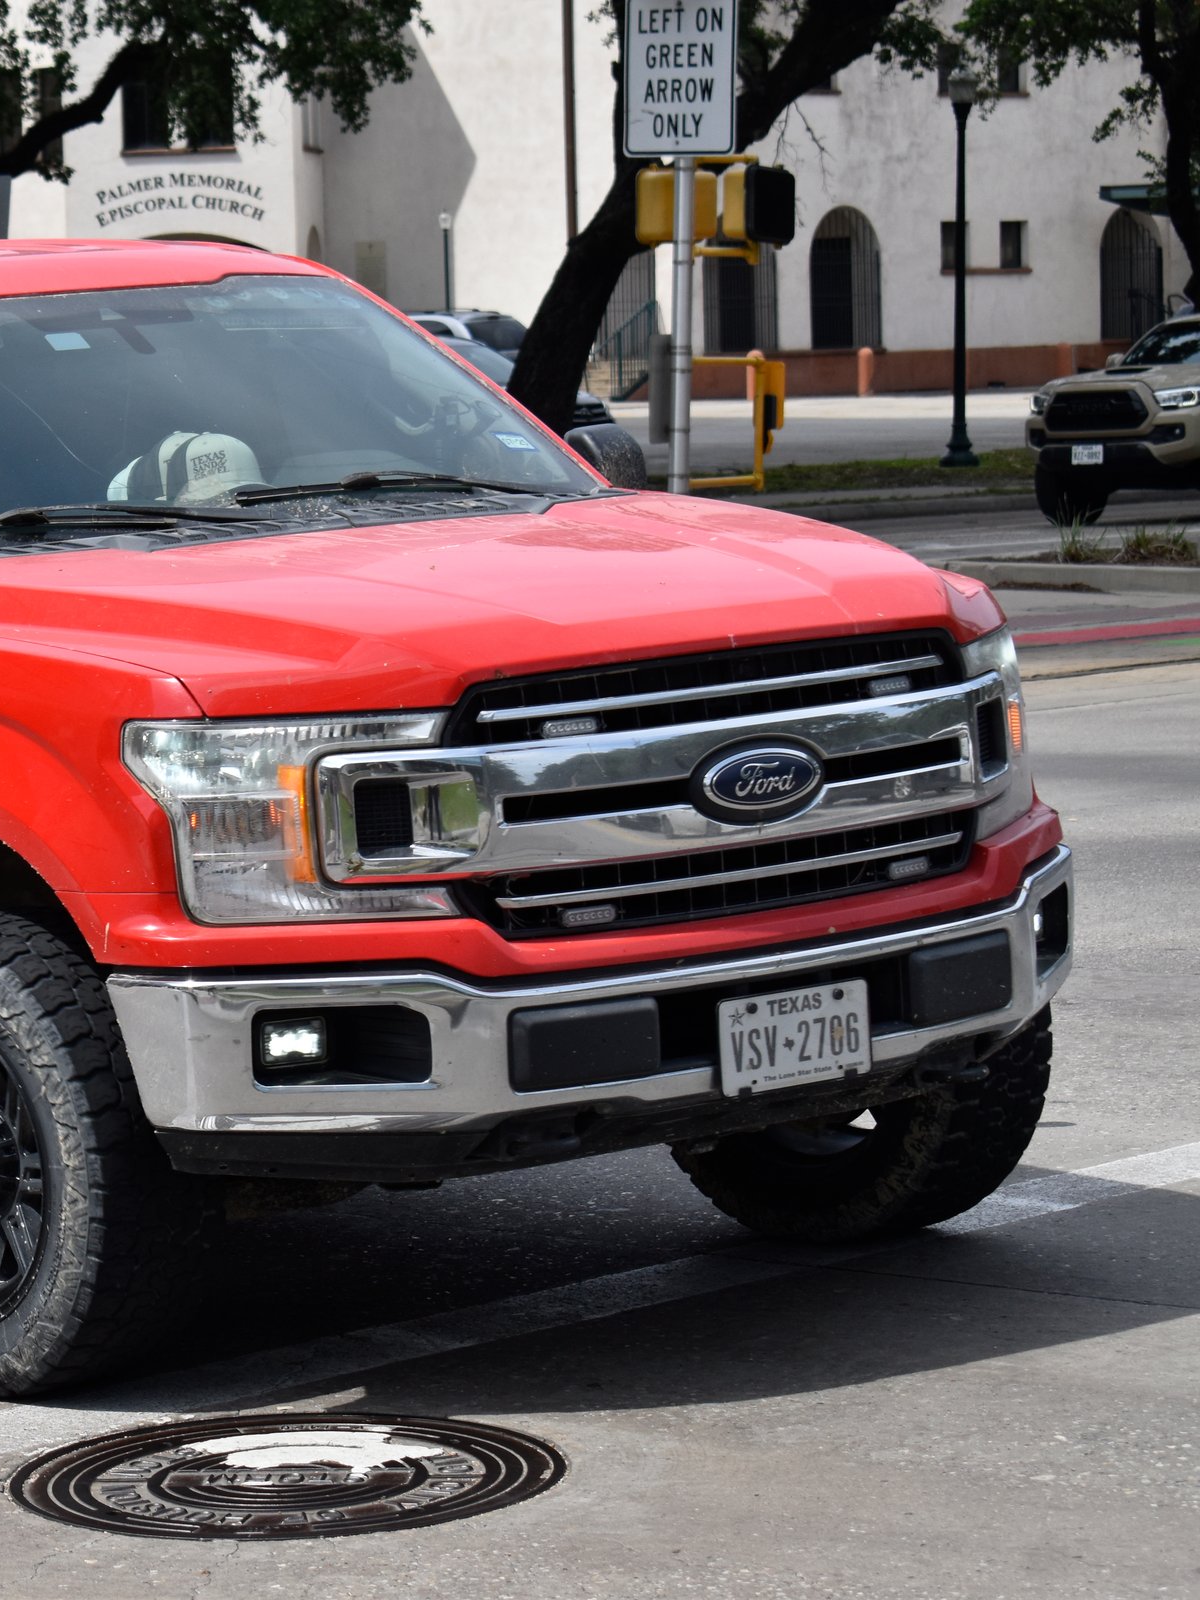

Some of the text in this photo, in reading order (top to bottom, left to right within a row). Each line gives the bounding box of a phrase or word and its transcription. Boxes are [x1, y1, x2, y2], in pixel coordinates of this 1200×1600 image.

[637, 7, 723, 34] LEFT ON
[645, 43, 713, 69] GREEN
[643, 78, 714, 103] ARROW
[652, 113, 703, 138] ONLY
[190, 450, 226, 466] TEXAS
[735, 761, 796, 797] Ford
[766, 992, 822, 1017] TEXAS
[779, 1072, 796, 1080] Lone
